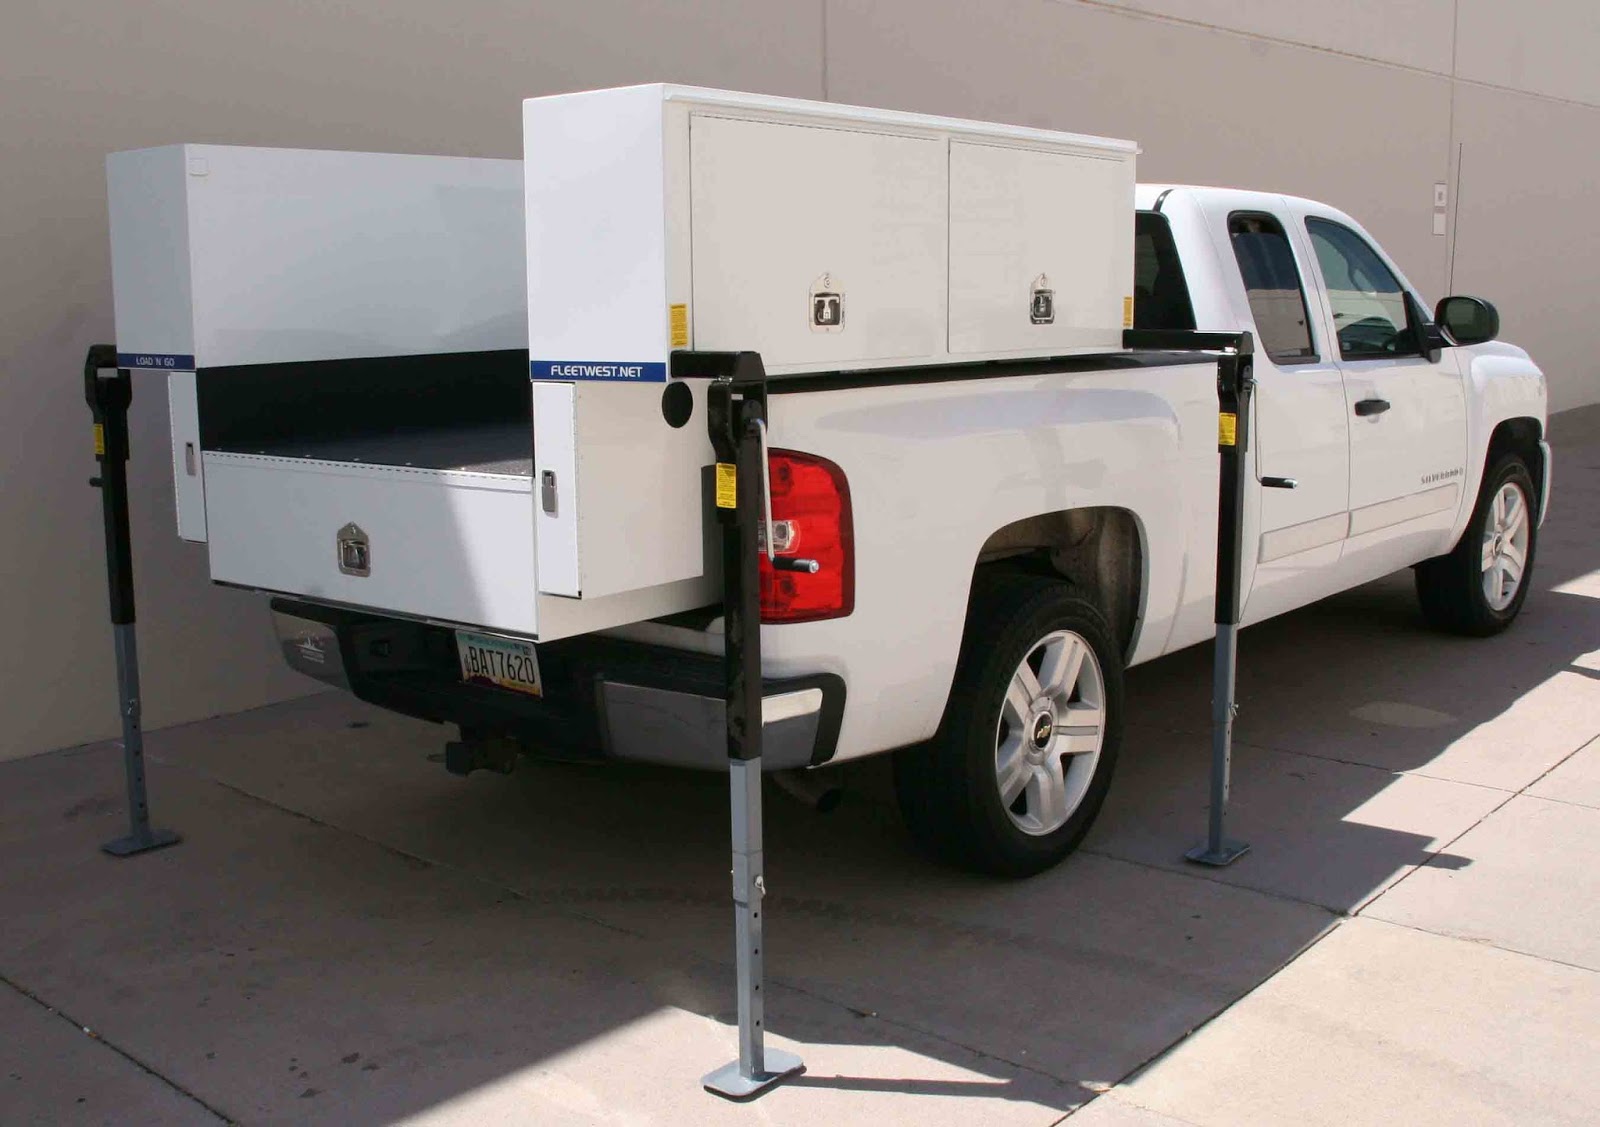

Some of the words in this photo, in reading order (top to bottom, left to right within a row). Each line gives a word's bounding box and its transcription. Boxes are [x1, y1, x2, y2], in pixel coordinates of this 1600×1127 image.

[136, 356, 153, 366] LOAD
[163, 357, 175, 367] GO
[551, 365, 643, 378] FLEETWEST.NET
